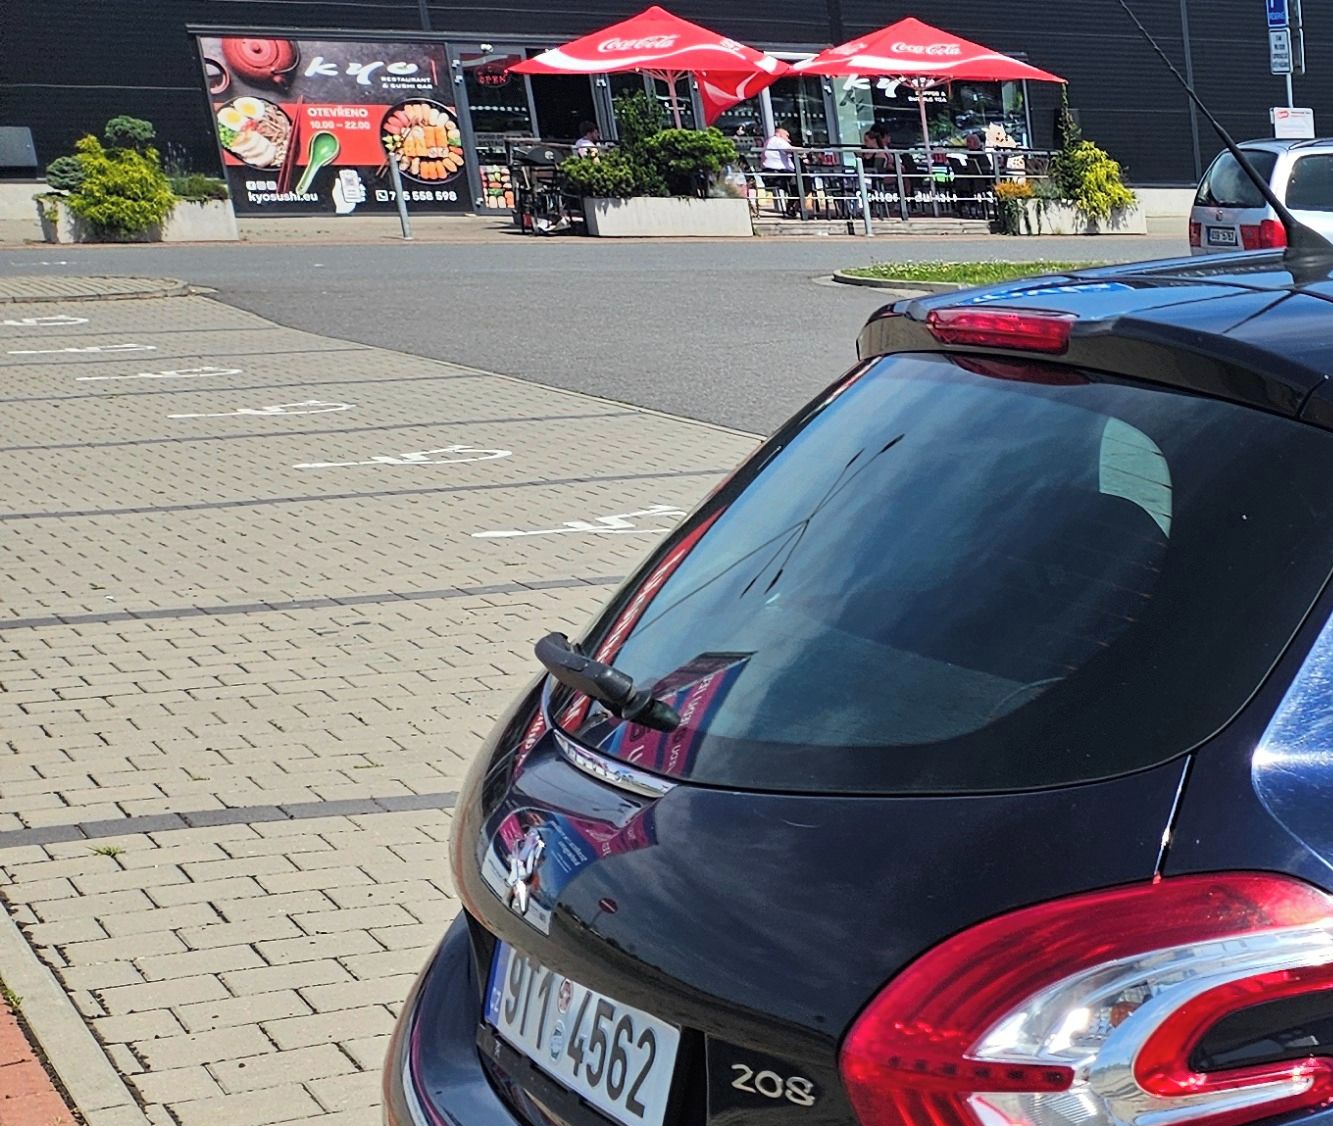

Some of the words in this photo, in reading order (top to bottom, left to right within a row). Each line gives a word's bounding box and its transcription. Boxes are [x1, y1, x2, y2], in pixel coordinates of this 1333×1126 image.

[307, 106, 368, 118] OTEVŘENO
[248, 191, 319, 204] kyosushi.eu
[567, 990, 656, 1118] 4562
[730, 1064, 816, 1107] 208
